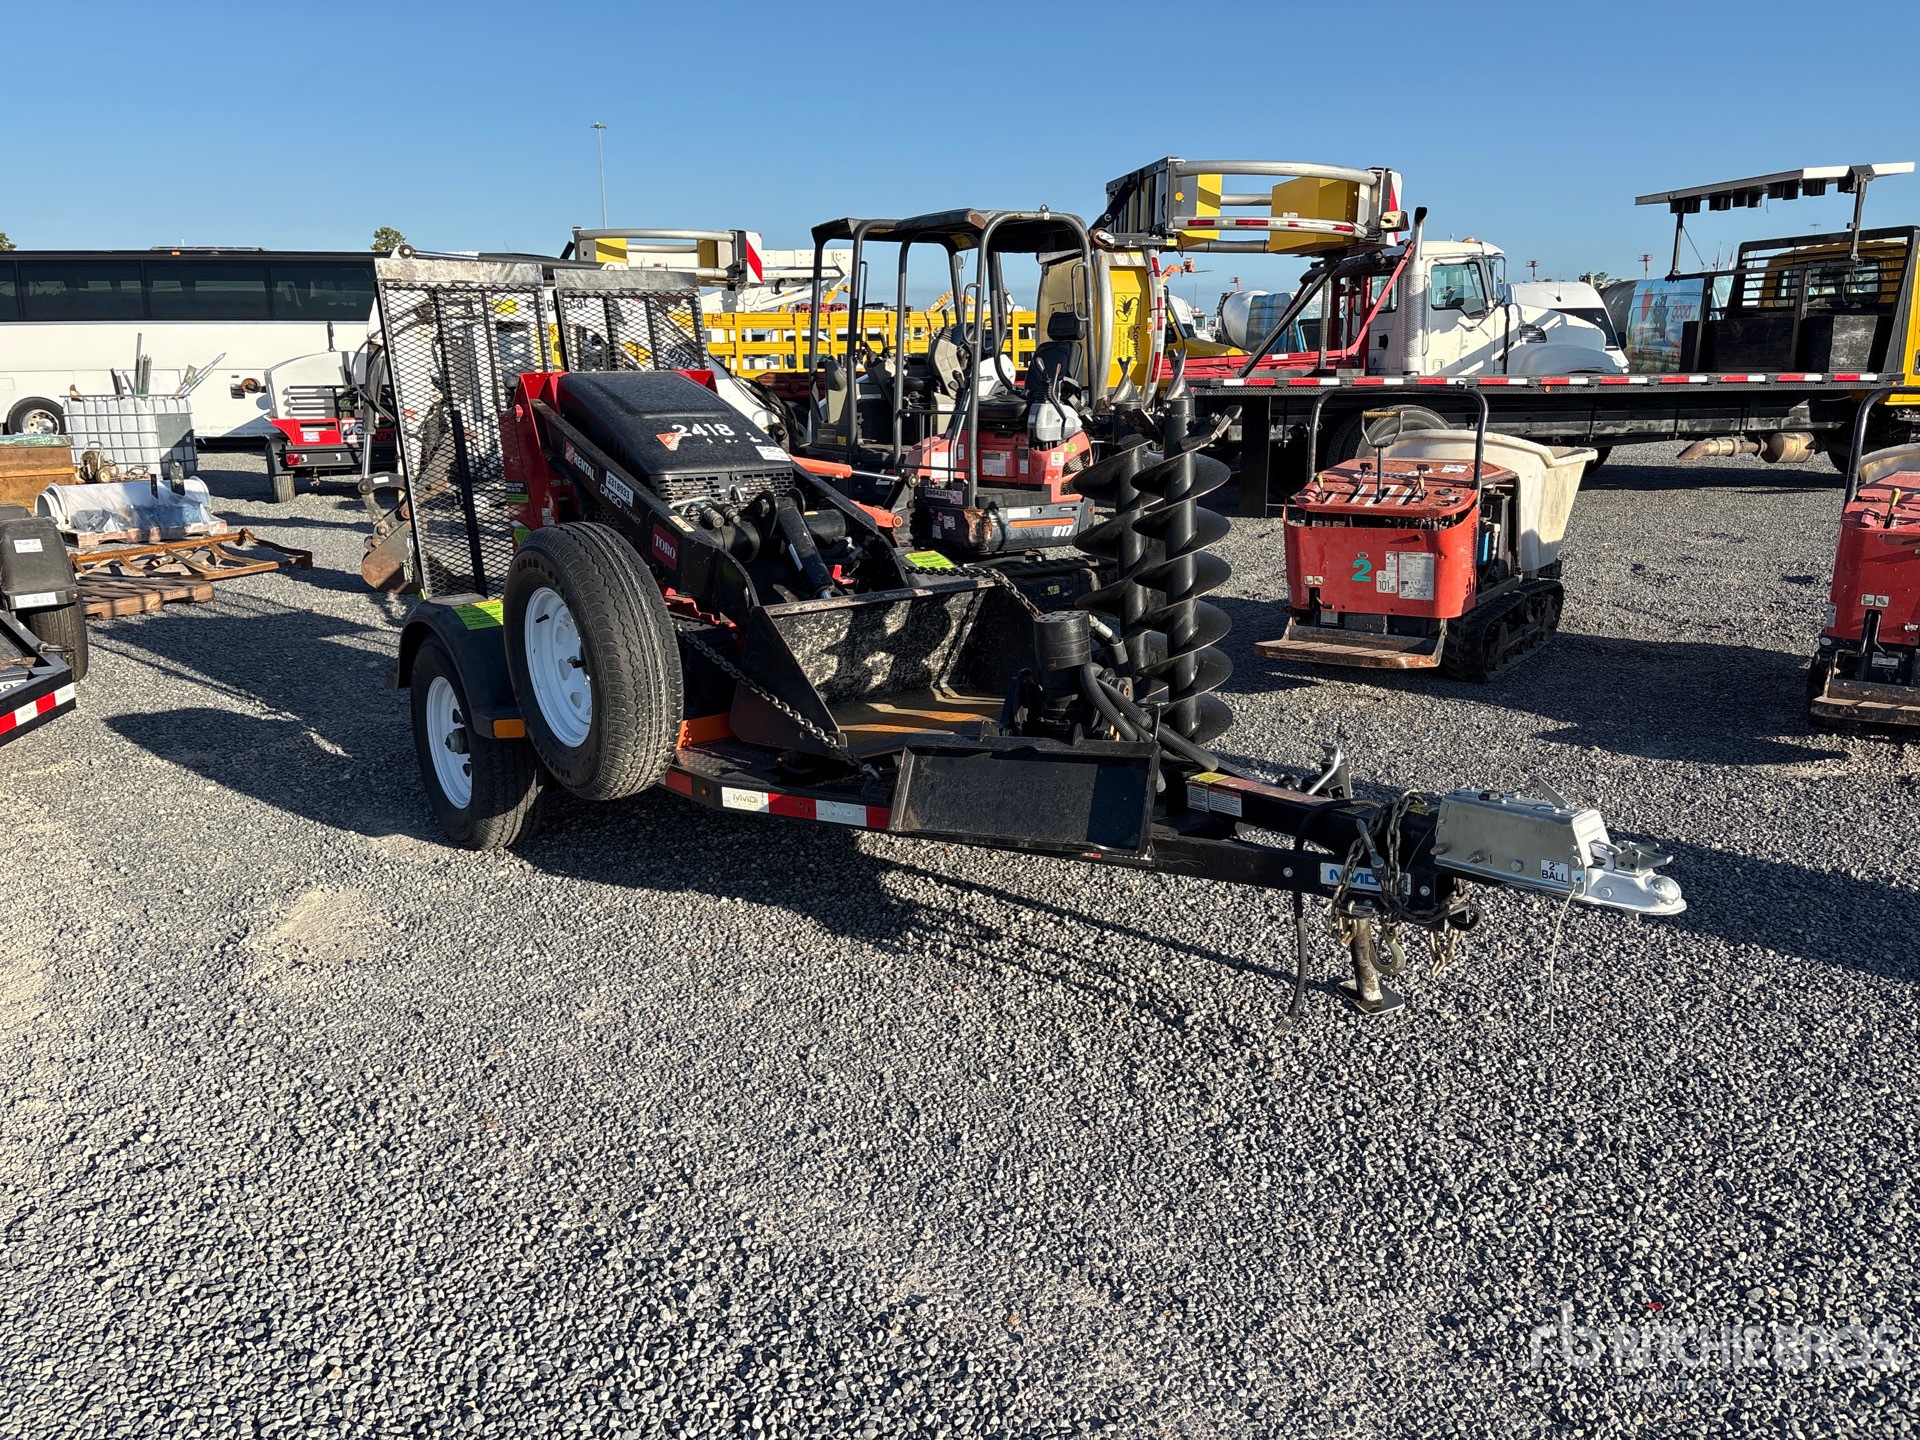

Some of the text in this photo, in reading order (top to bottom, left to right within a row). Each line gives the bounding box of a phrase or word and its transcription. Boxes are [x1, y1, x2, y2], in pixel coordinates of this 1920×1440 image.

[671, 423, 736, 437] 2418
[573, 452, 596, 482] RENTAL
[600, 483, 623, 509] DINGO
[607, 475, 630, 500] 3318933
[1052, 525, 1074, 537] U17
[654, 533, 677, 560] TORO
[1351, 559, 1372, 582] 2
[1378, 580, 1390, 591] 101
[1548, 861, 1560, 871] 2"
[1541, 870, 1568, 883] BALL
